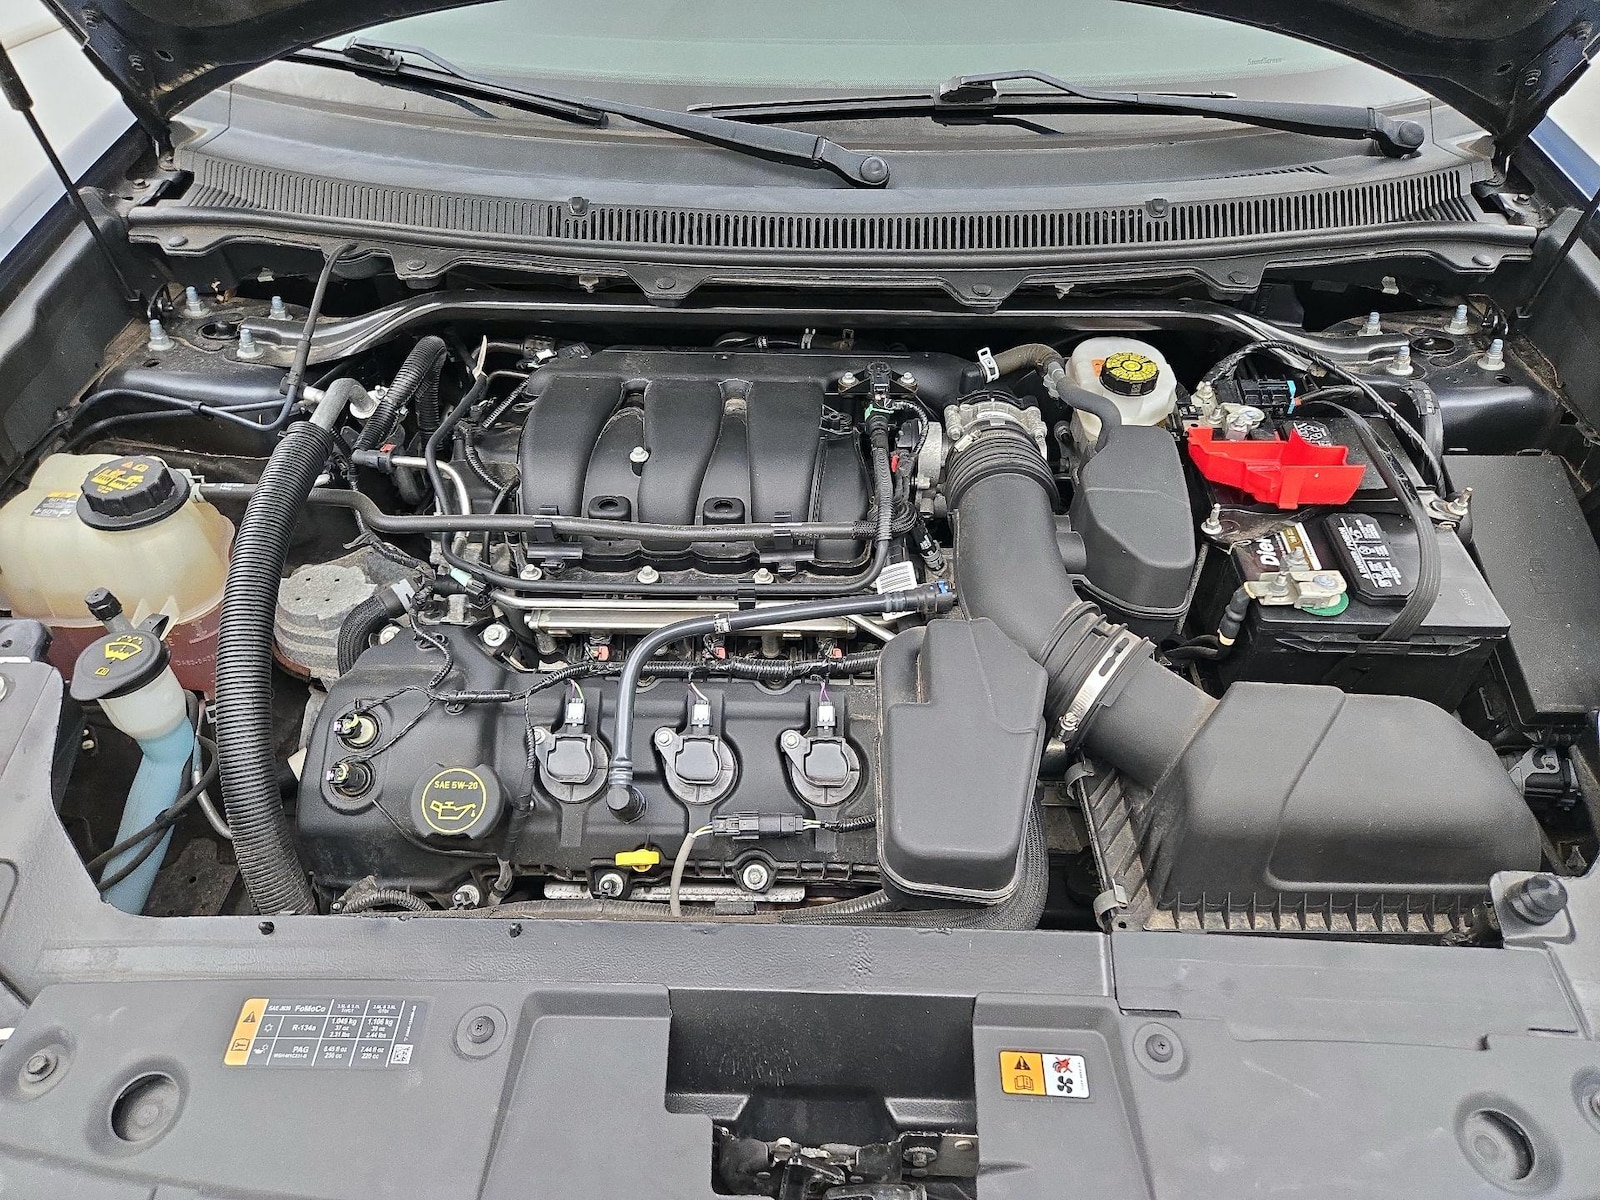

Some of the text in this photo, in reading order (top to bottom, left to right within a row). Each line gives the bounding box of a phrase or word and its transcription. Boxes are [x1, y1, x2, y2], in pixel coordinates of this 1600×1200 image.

[434, 781, 478, 790] SAE 5W-20
[294, 1005, 326, 1013] FoMoCo
[349, 1018, 357, 1027] kg
[385, 1019, 393, 1028] kg
